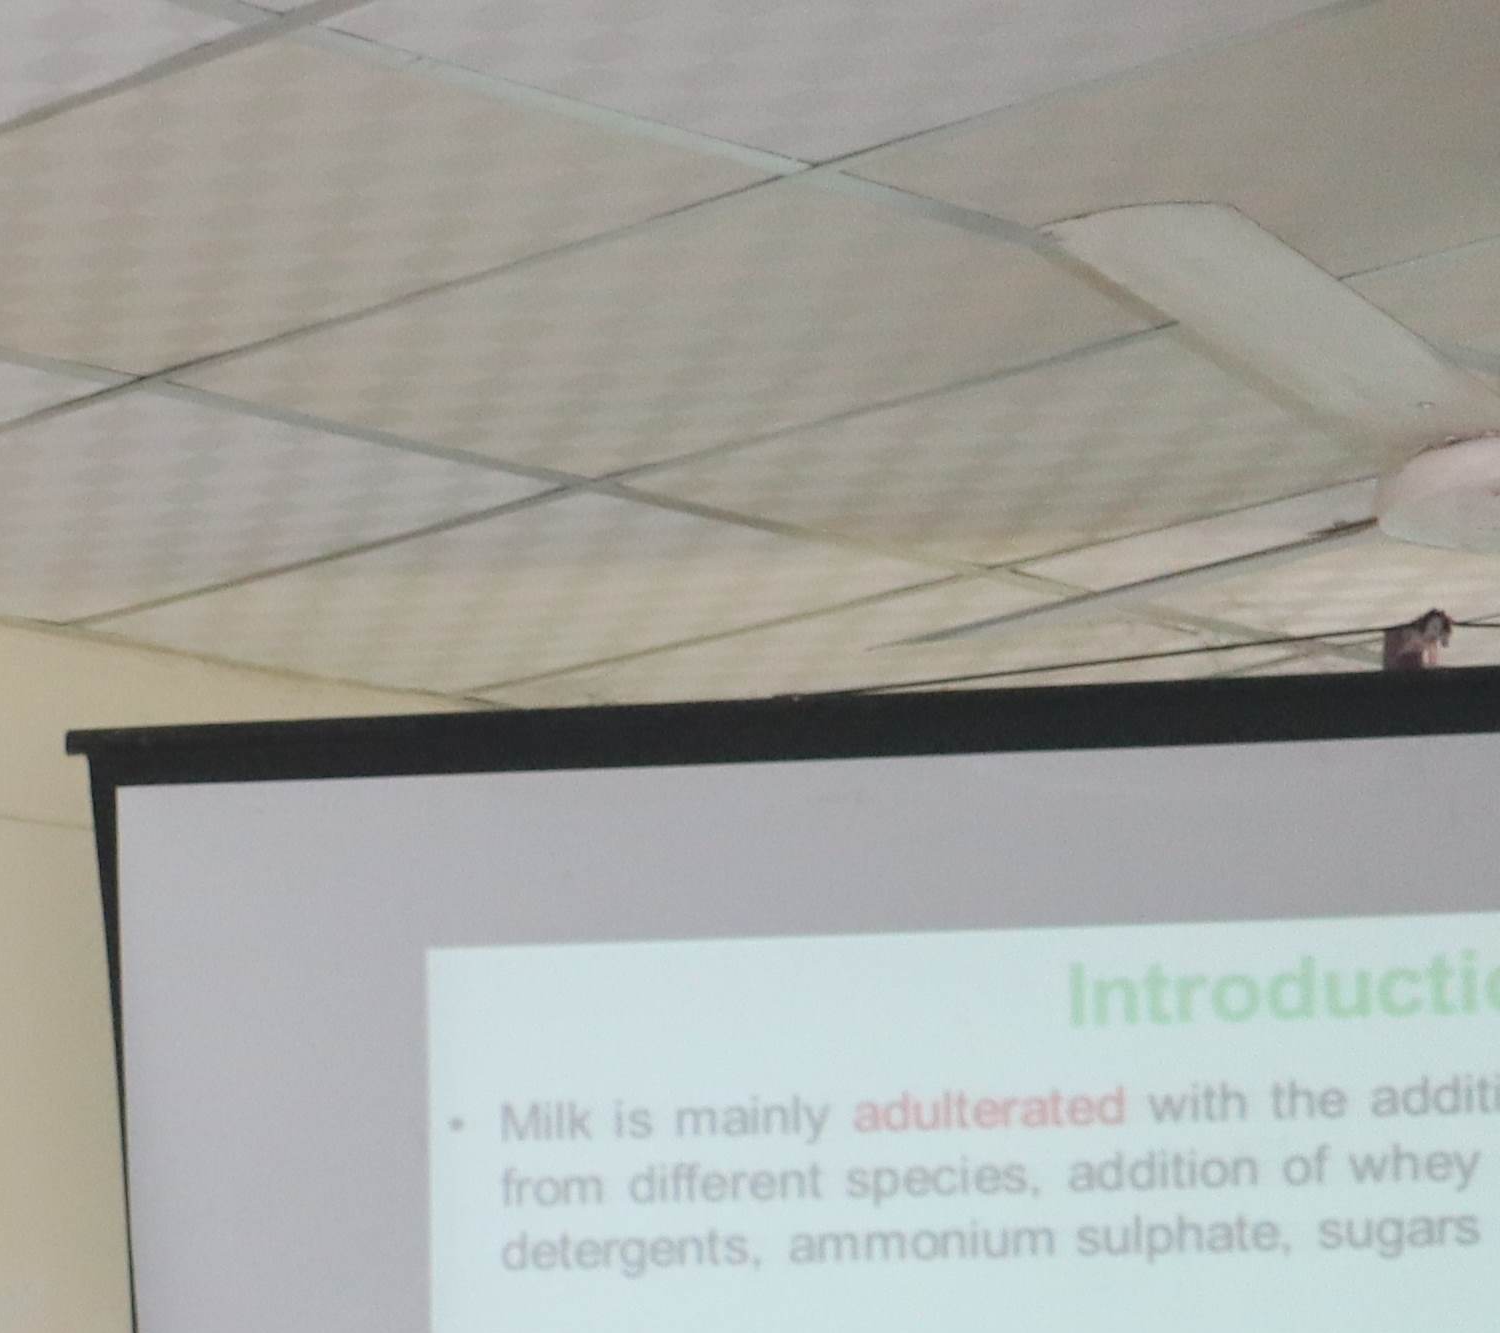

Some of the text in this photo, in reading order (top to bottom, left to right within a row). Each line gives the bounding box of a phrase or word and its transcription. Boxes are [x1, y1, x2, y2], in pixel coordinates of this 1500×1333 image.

[501, 1080, 1348, 1145] Milk is mainly adulterated with the
[501, 1143, 1481, 1208] from different species, addition of whey
[502, 1214, 1482, 1278] detergents, ammonium sulphate, sugars
